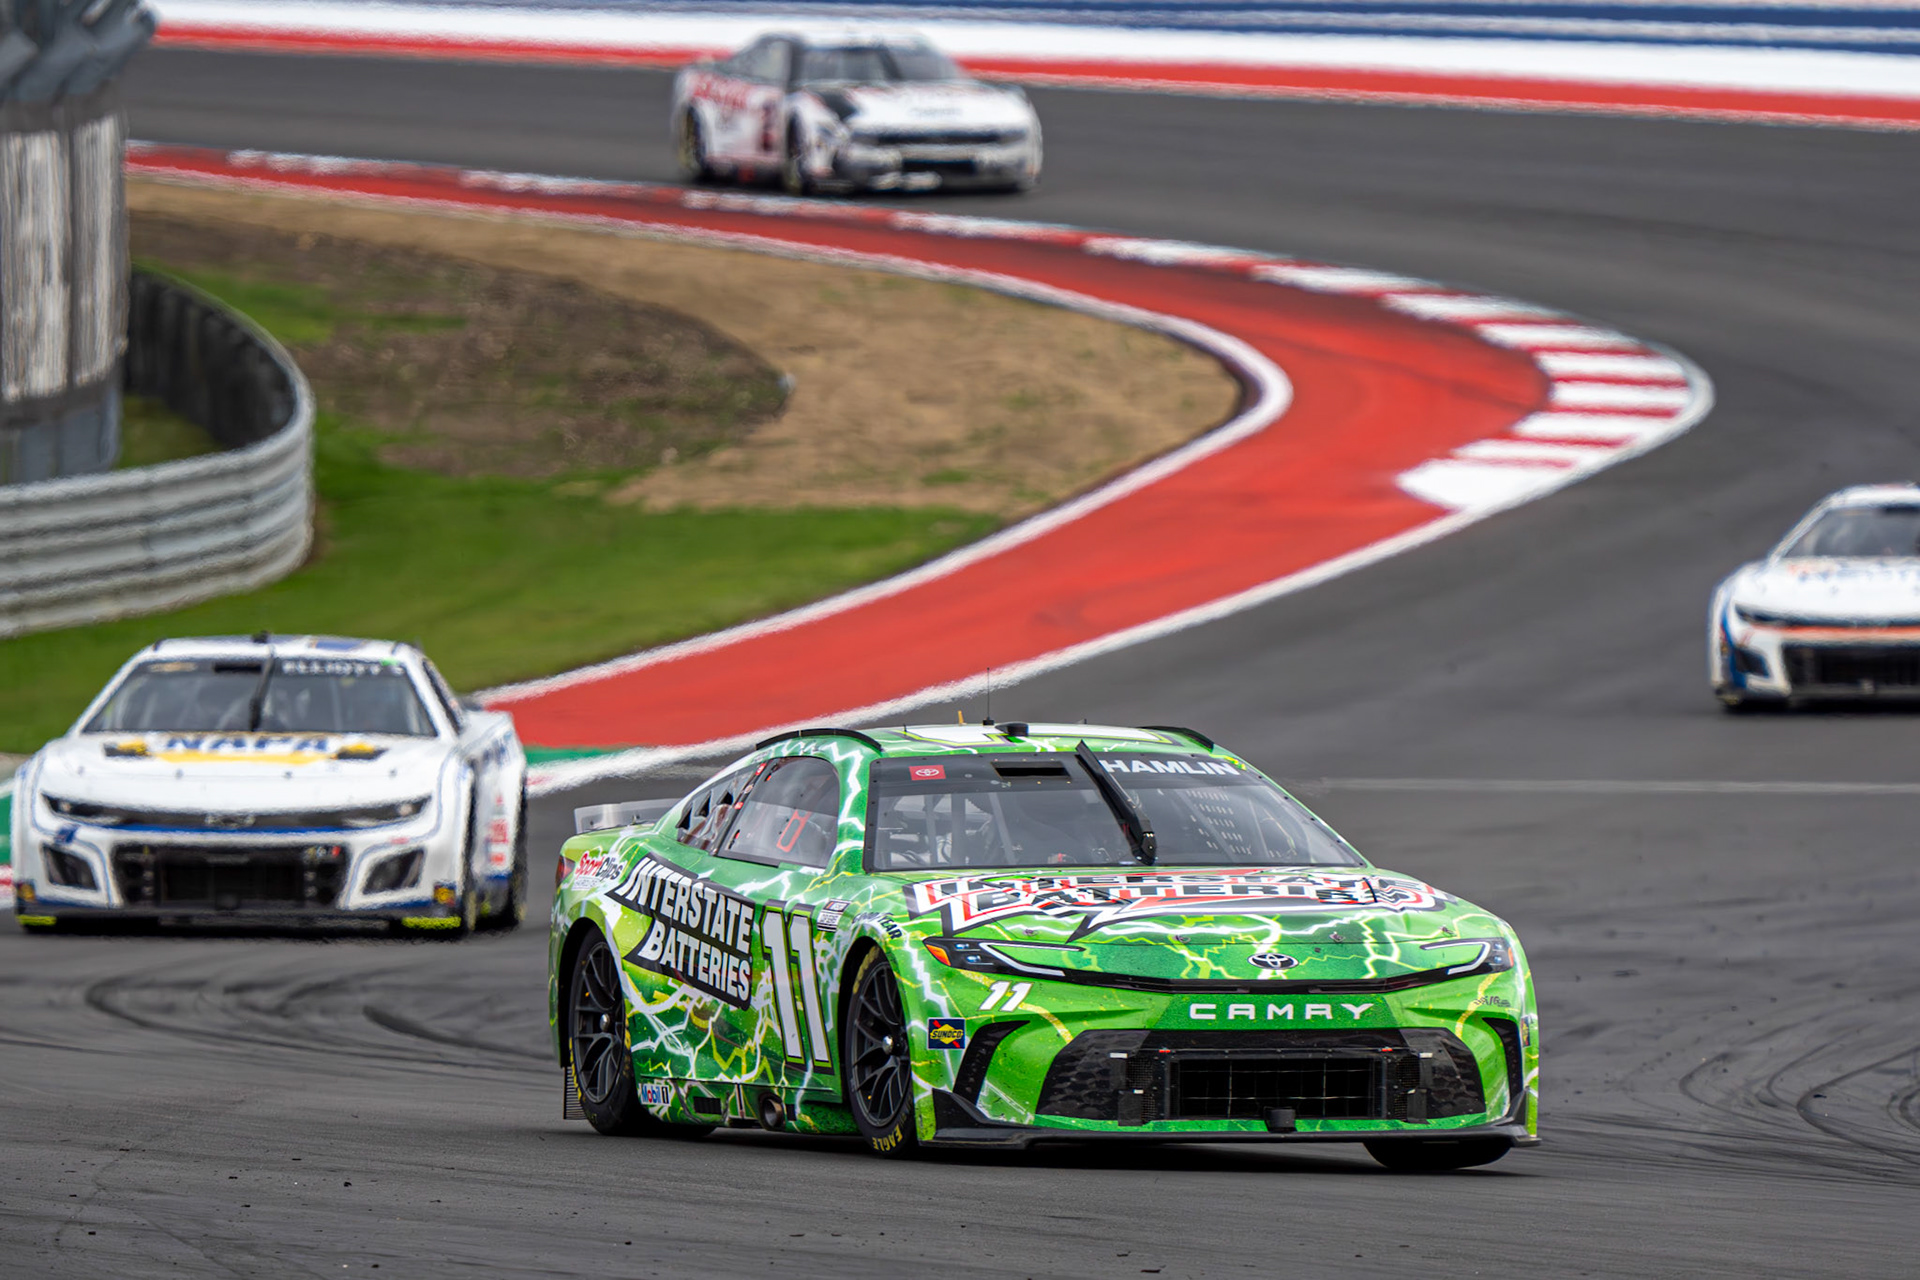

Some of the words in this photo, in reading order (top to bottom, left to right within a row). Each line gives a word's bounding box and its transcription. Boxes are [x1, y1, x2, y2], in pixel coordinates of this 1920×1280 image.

[1099, 759, 1241, 775] HAMLIN
[614, 856, 755, 955] INTERSTATE
[637, 919, 753, 1002] BATTERIES
[762, 908, 831, 1066] 11
[979, 981, 1034, 1012] 11
[1189, 1003, 1375, 1020] CAMRY
[932, 1030, 963, 1039] SUNOCO
[872, 1124, 903, 1151] EAGLE
